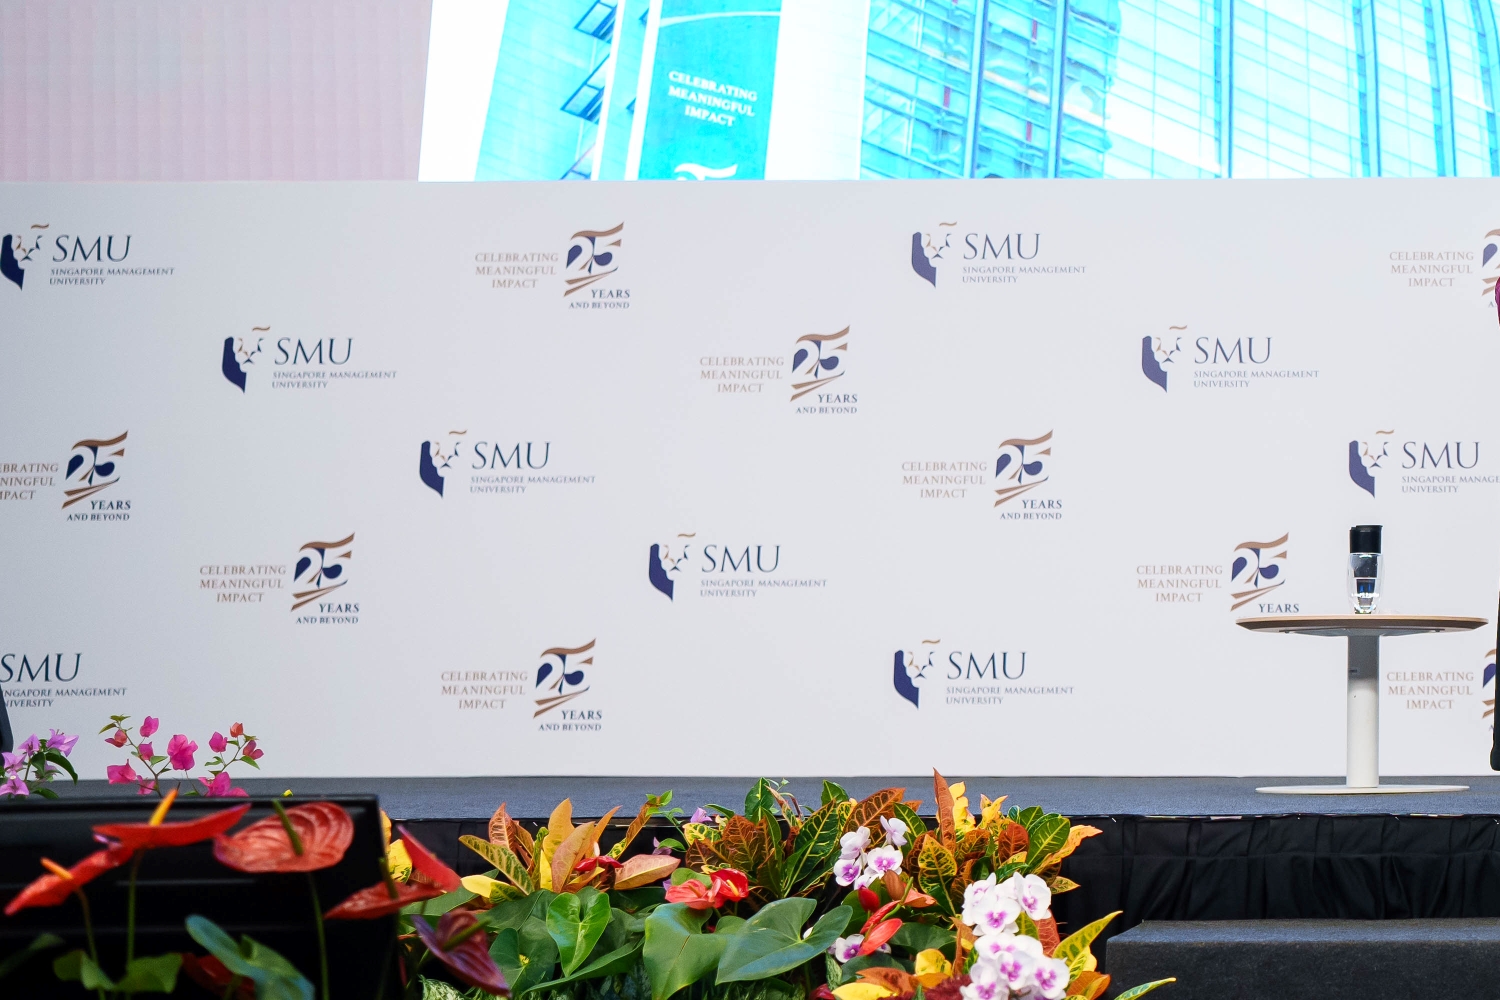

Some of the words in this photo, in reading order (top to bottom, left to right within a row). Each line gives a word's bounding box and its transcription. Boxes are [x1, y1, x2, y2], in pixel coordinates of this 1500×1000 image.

[668, 70, 757, 102] CELEBRATING
[668, 85, 756, 116] MEANINGFUL
[685, 106, 735, 127] IMPACT
[52, 235, 132, 262] SMU
[474, 253, 559, 262] CELEBRATING
[475, 266, 555, 275] MEANINGFUL
[491, 279, 537, 288] IMPACT
[591, 289, 631, 298] YEARS
[274, 338, 353, 364] SMU
[471, 442, 551, 469] SMU
[901, 462, 988, 471] CELEBRATING
[902, 476, 984, 484] MEANINGFUL
[920, 489, 966, 498] IMPACT
[1021, 500, 1063, 509] YEARS
[701, 545, 780, 572] SMU
[199, 565, 287, 575] CELEBRATING
[199, 579, 283, 589] MEANINGFUL
[216, 593, 265, 602] IMPACT
[318, 603, 360, 613] YEARS
[295, 616, 318, 624] AND
[319, 616, 359, 624] BEYOND
[947, 652, 1026, 679] SMU
[440, 672, 528, 681] CELEBRATING
[1386, 672, 1475, 681] CELEBRATING
[441, 685, 524, 695] MEANINGFUL
[1388, 686, 1474, 695] MEANINGFUL
[458, 699, 506, 709] IMPACT
[1406, 700, 1454, 709] IMPACT
[561, 710, 603, 720] YEARS
[561, 723, 602, 731] BEYOND
